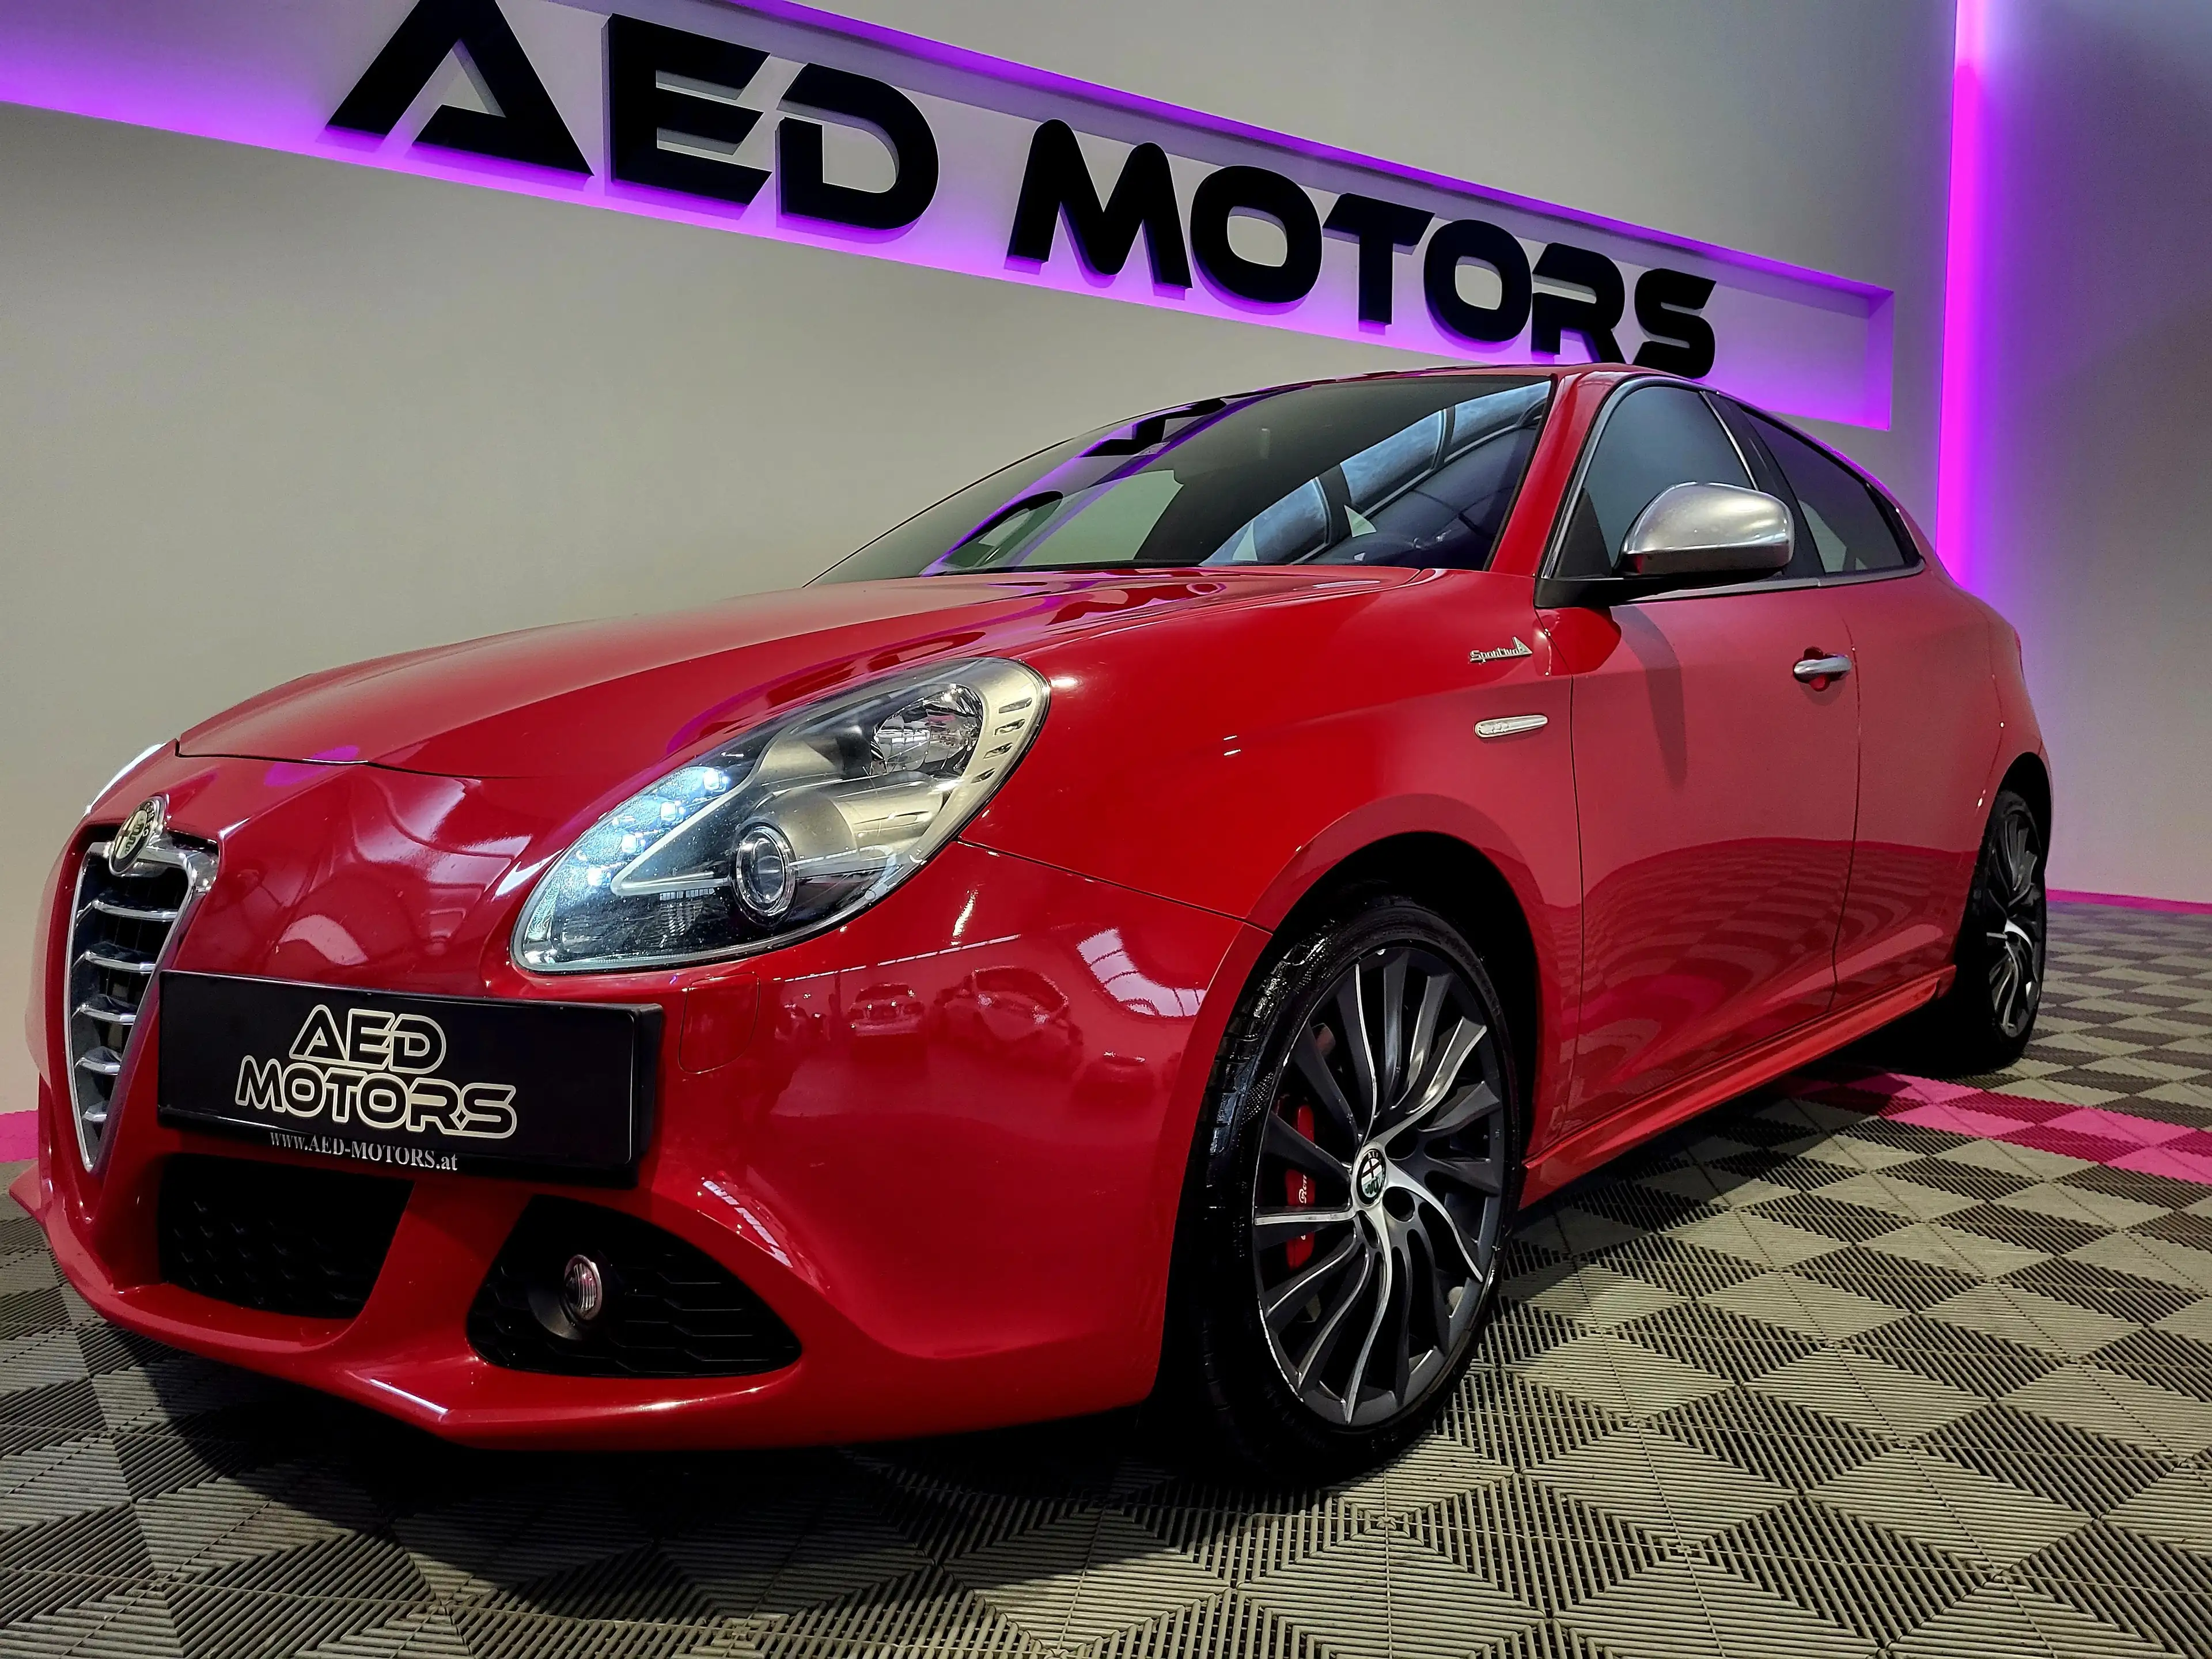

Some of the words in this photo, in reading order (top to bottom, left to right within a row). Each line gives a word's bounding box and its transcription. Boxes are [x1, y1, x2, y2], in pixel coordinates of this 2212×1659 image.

[324, 0, 940, 232] AED
[1006, 118, 1717, 378] MOTORS
[289, 1004, 446, 1074] AED
[235, 1055, 517, 1139] MOTORS
